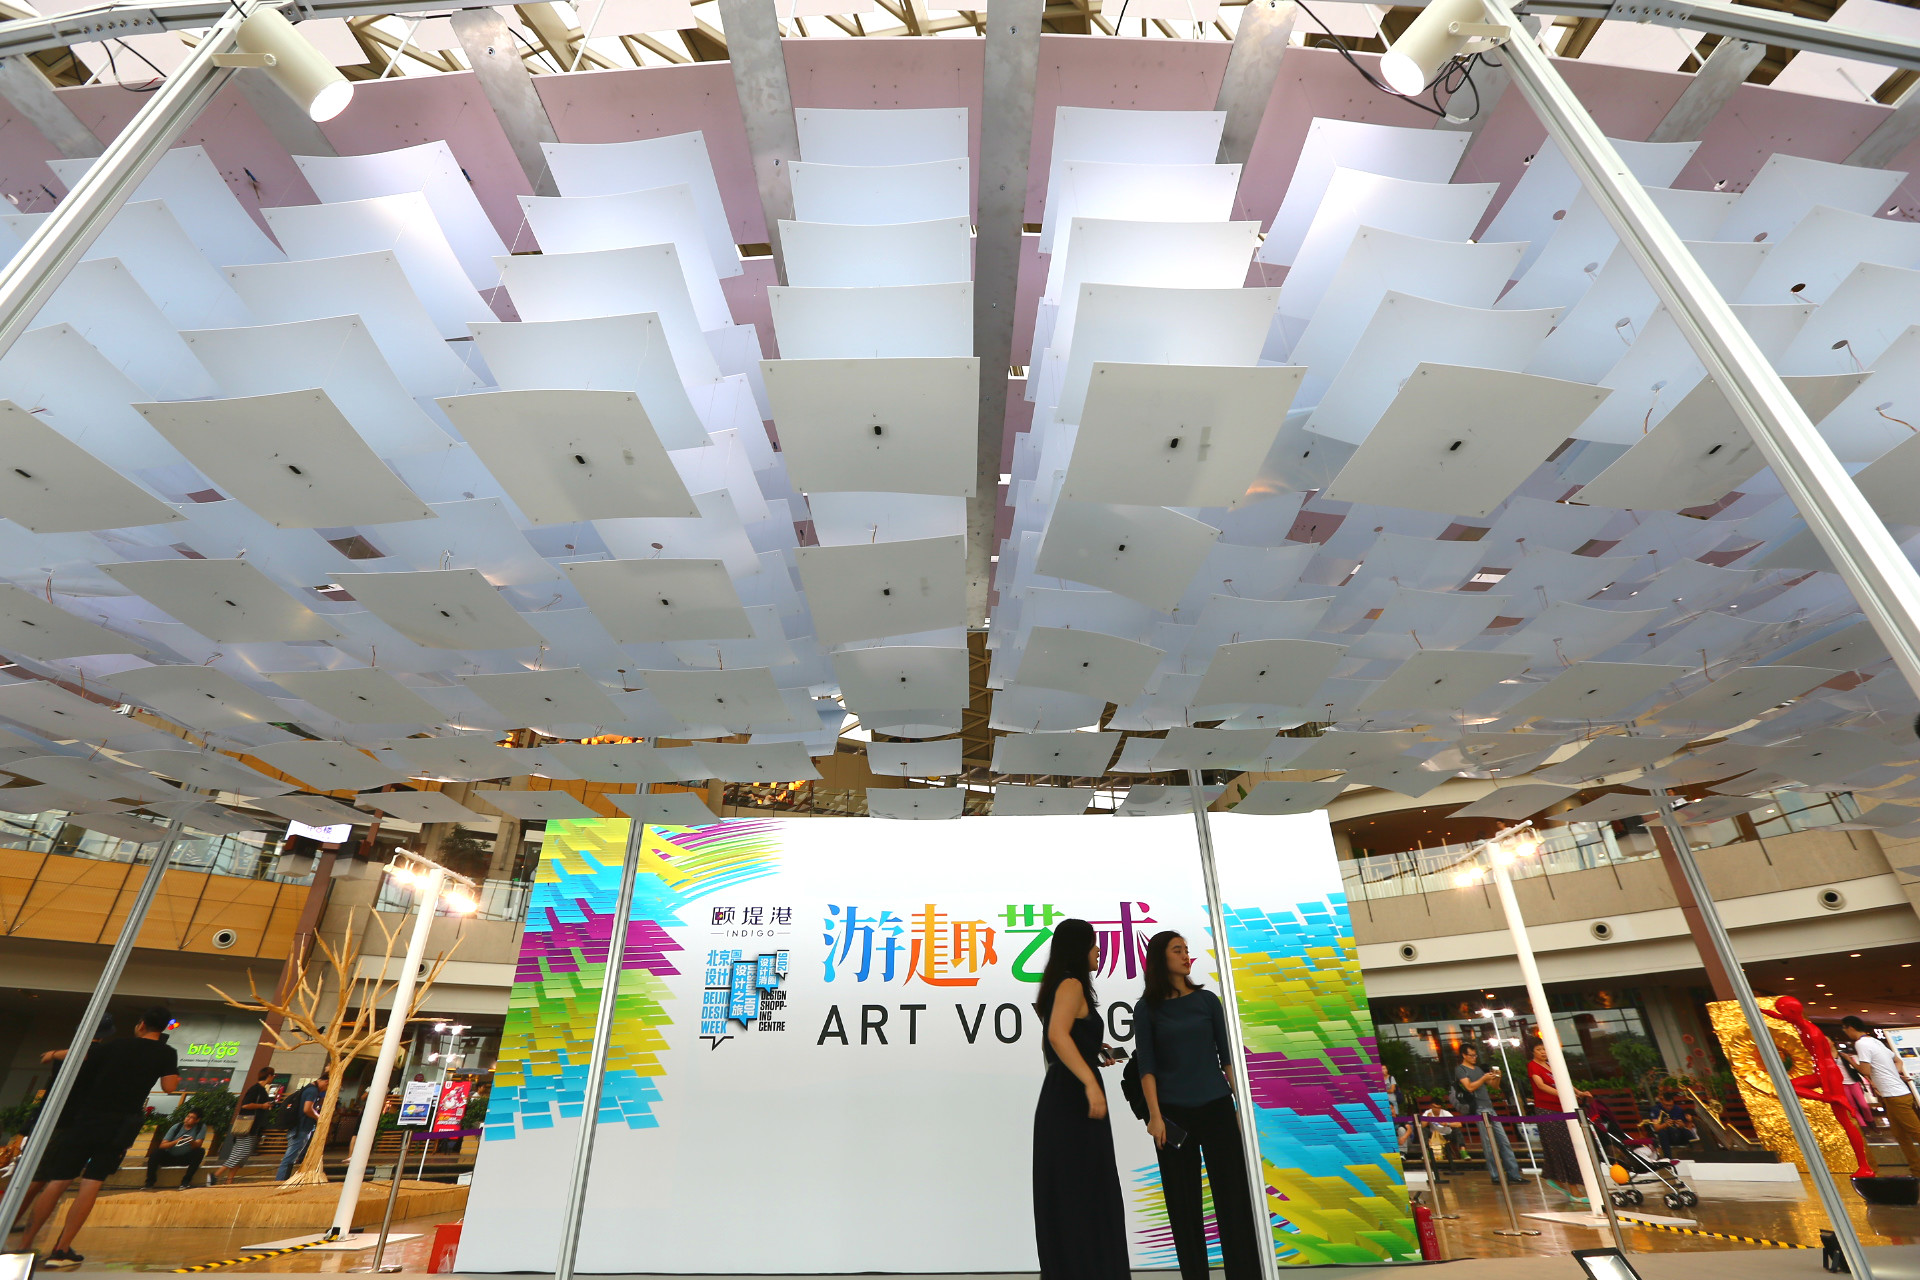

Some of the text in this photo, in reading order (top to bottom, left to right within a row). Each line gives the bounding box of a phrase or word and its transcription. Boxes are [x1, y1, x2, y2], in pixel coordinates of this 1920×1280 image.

[711, 906, 793, 926] 颐堤港
[726, 929, 775, 938] INDIGO
[823, 901, 1197, 987] 游趣艺术
[777, 952, 788, 972] 2016
[704, 968, 732, 986] 设计
[703, 991, 731, 1005] BEIJIN
[731, 964, 748, 1017] 设计之旅
[701, 1006, 729, 1020] DESIG
[743, 997, 756, 1017] HOP
[760, 1001, 787, 1011] SHOPP-
[759, 1011, 772, 1021] ING
[817, 1001, 1136, 1046] ART VOG
[700, 1021, 728, 1034] WEEK
[758, 1021, 786, 1032] CENTRE
[187, 1043, 239, 1060] bibigo
